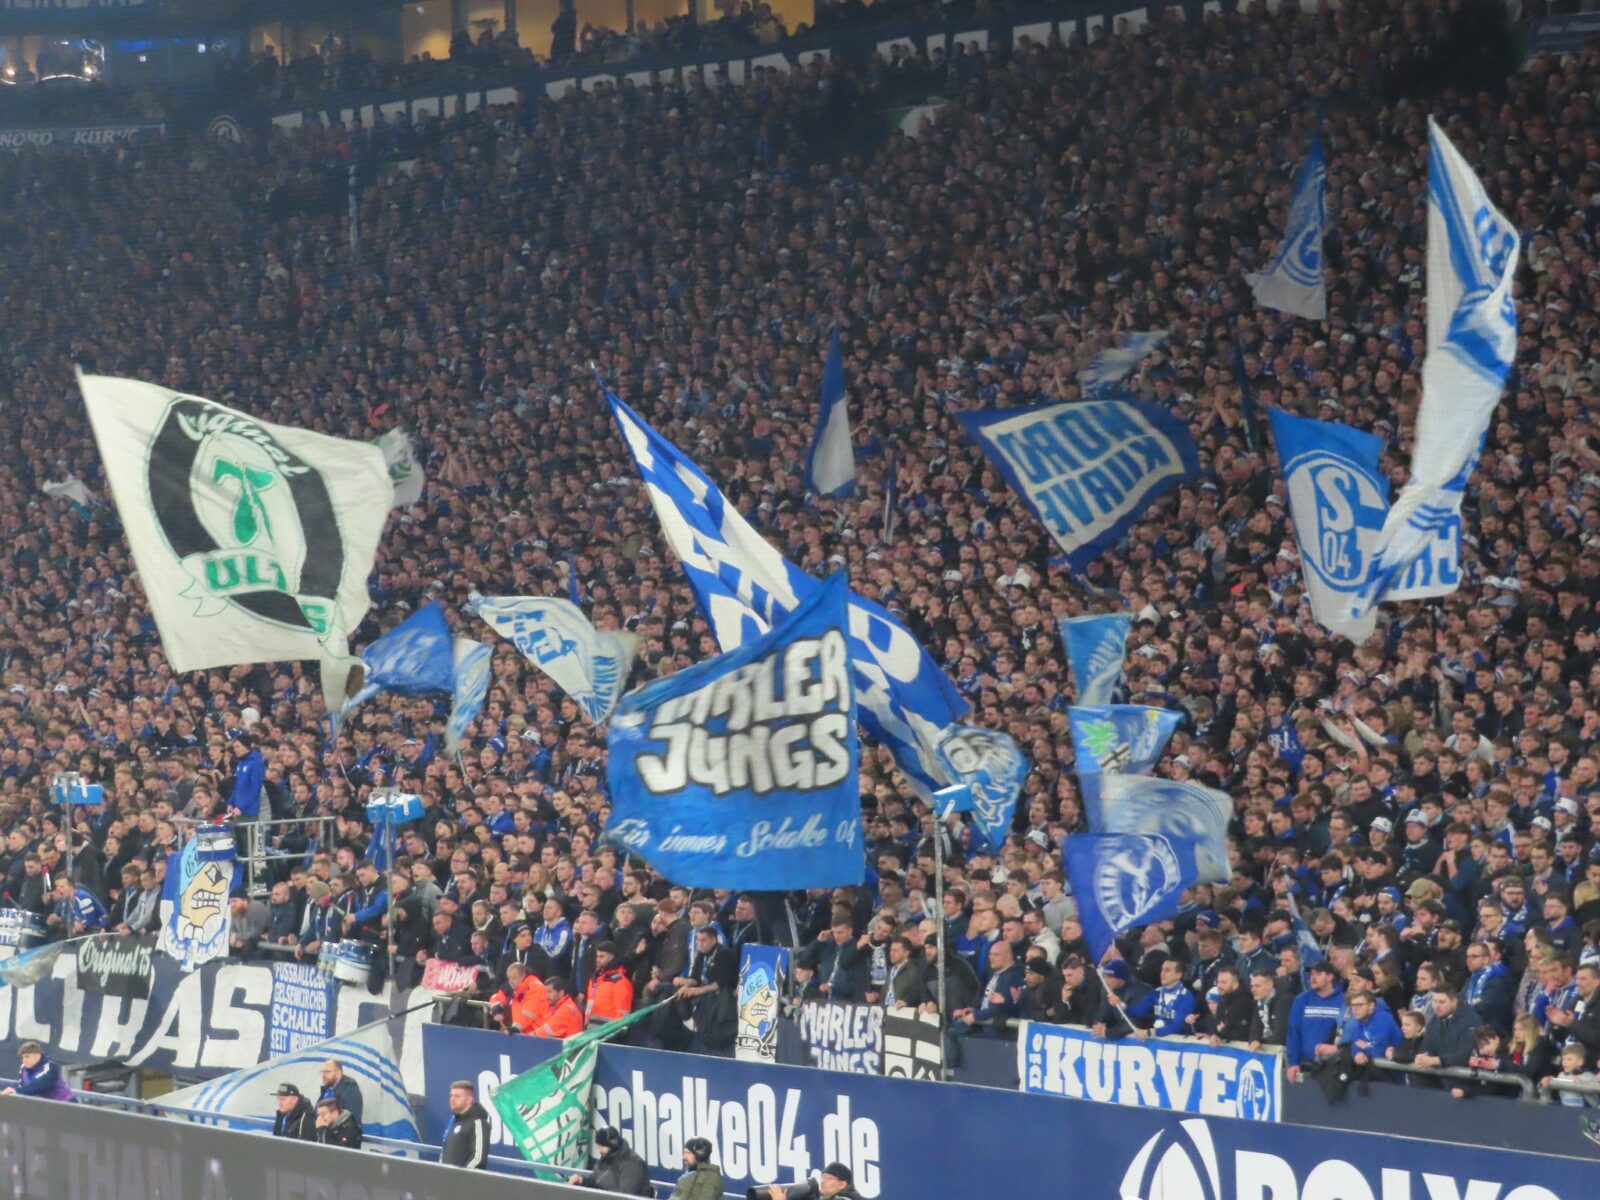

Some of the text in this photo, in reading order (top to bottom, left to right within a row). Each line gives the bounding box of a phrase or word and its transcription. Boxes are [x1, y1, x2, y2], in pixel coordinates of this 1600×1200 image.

[636, 713, 850, 794] JUNGS
[835, 818, 856, 849] 04
[79, 937, 140, 987] Original
[271, 1027, 288, 1052] SEIT
[272, 1003, 327, 1035] SCHALKE
[800, 1001, 885, 1053] MARLER
[1044, 1034, 1238, 1118] KURVE
